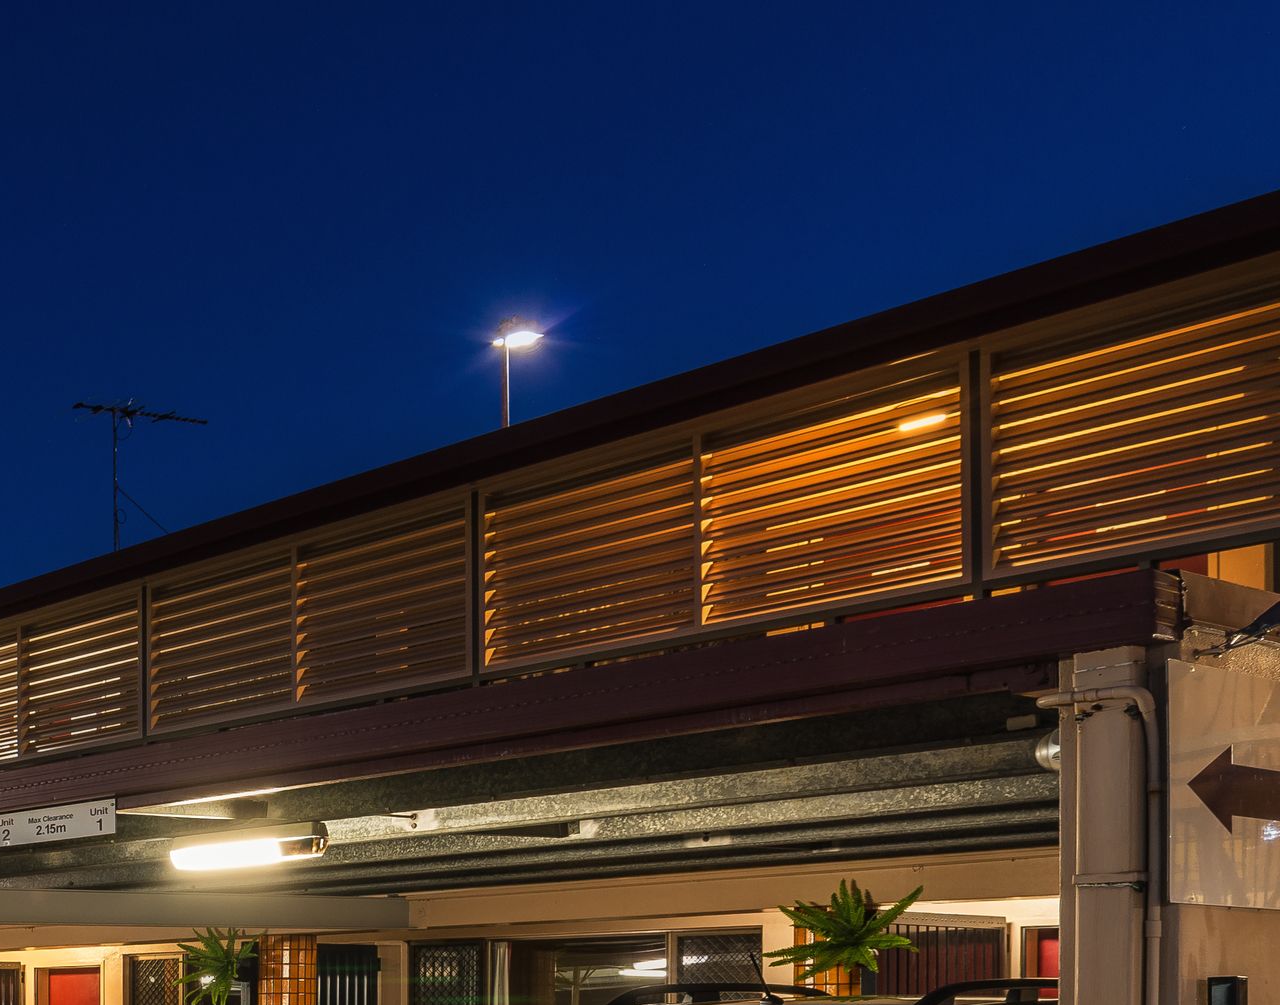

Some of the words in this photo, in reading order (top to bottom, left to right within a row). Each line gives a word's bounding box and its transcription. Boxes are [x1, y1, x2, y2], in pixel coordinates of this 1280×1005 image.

[42, 813, 74, 822] Clearance
[90, 807, 108, 816] Unit
[36, 823, 66, 835] 2.15m
[96, 818, 103, 831] 1
[1, 829, 10, 841] 2
